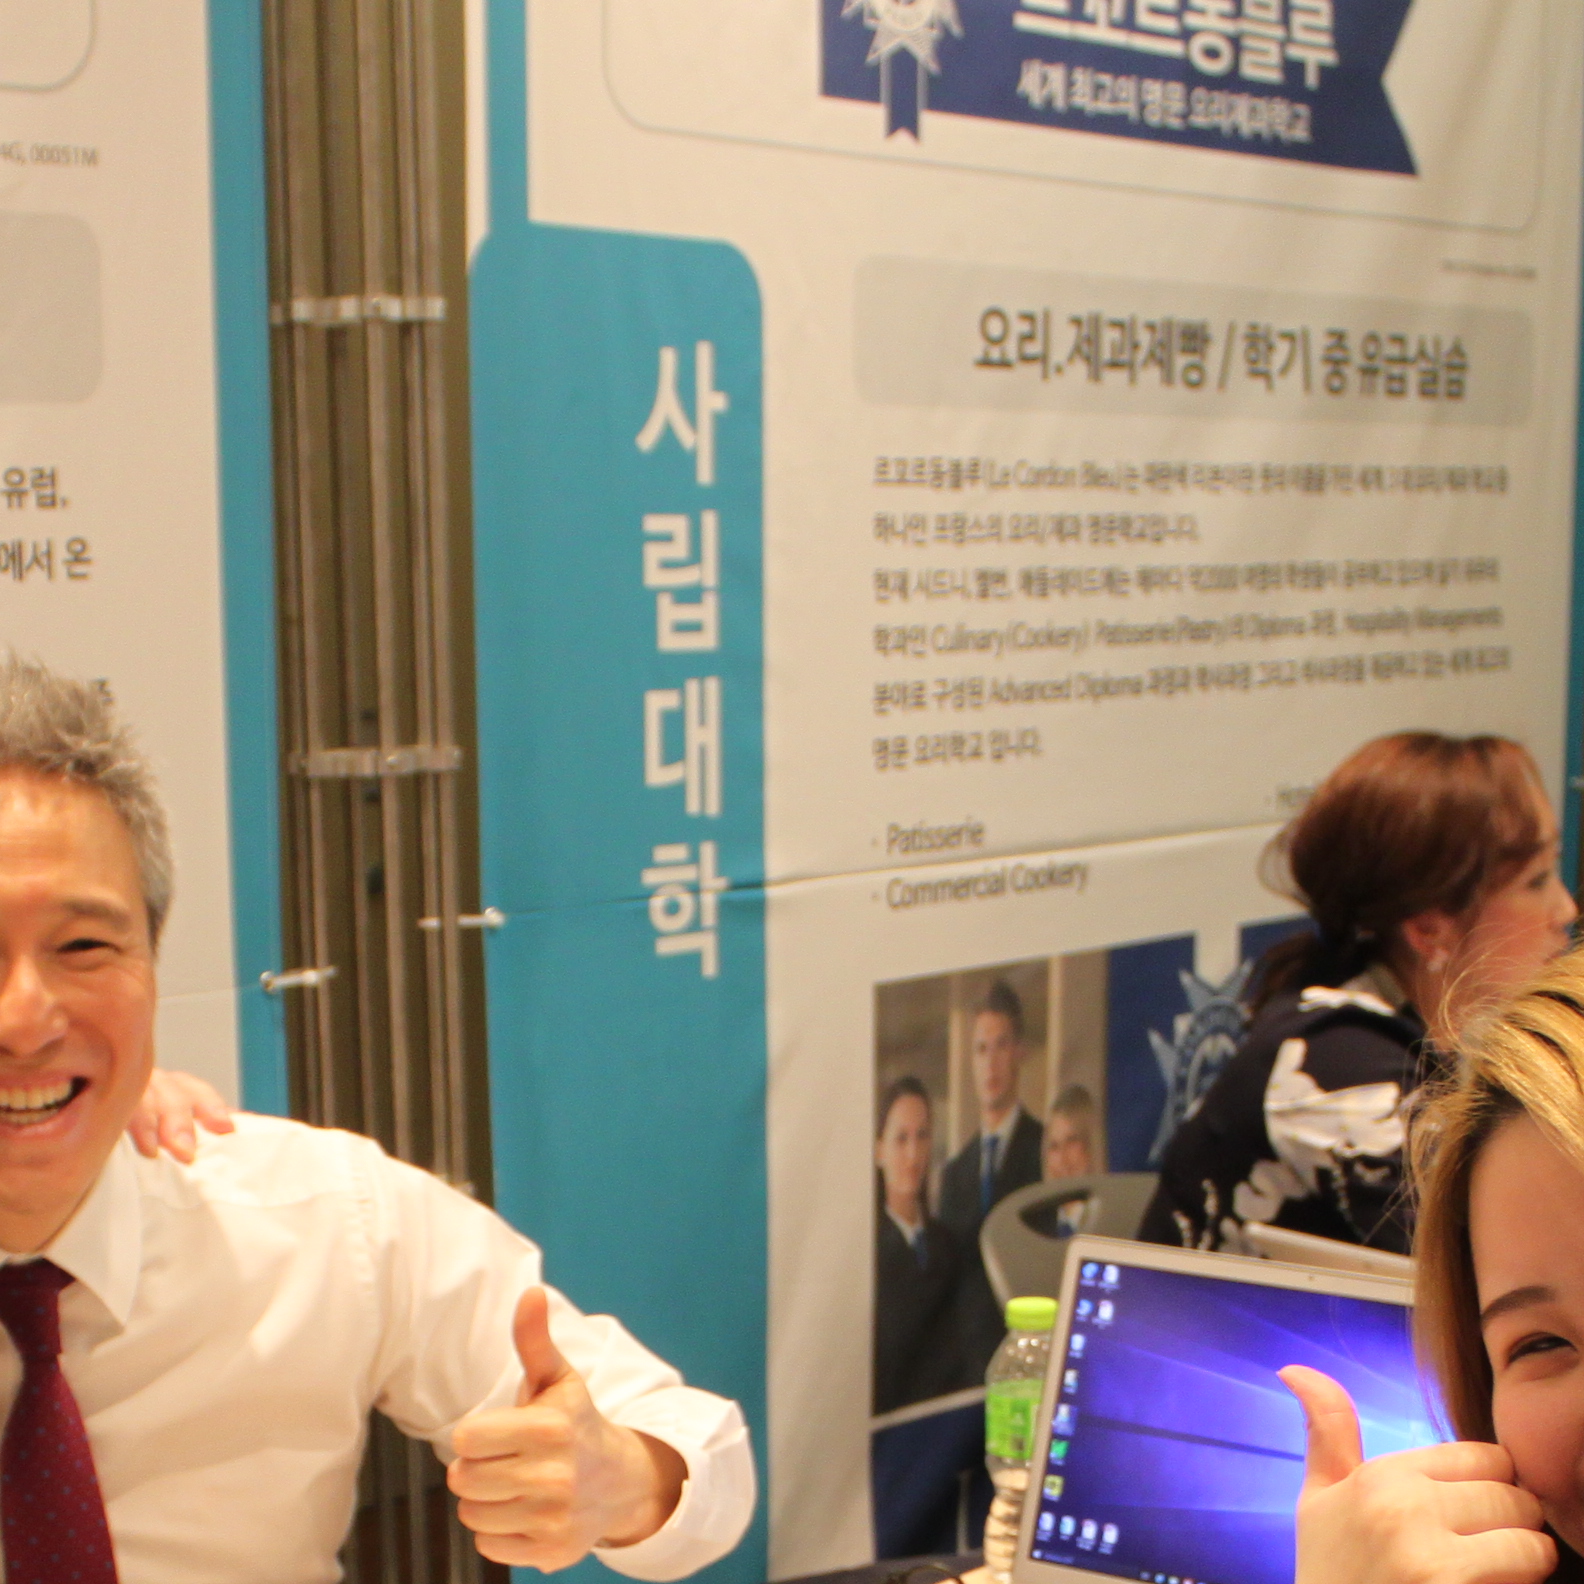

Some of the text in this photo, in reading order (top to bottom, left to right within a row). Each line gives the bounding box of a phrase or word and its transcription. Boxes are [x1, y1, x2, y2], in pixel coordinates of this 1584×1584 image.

[1018, 58, 1069, 113] 세계
[1070, 66, 1140, 124] 최고의
[1141, 78, 1187, 131] 명문
[973, 306, 1213, 392] 요리.제과제빵
[1244, 322, 1312, 393] 학기
[1321, 328, 1351, 395] 중
[1357, 331, 1468, 399] 유급실습
[1, 467, 68, 510] 유럽,
[62, 537, 92, 579] 온
[635, 340, 731, 980] 사립대학
[886, 818, 985, 855] Patisserie
[886, 859, 1090, 910] Commercial Cookery
